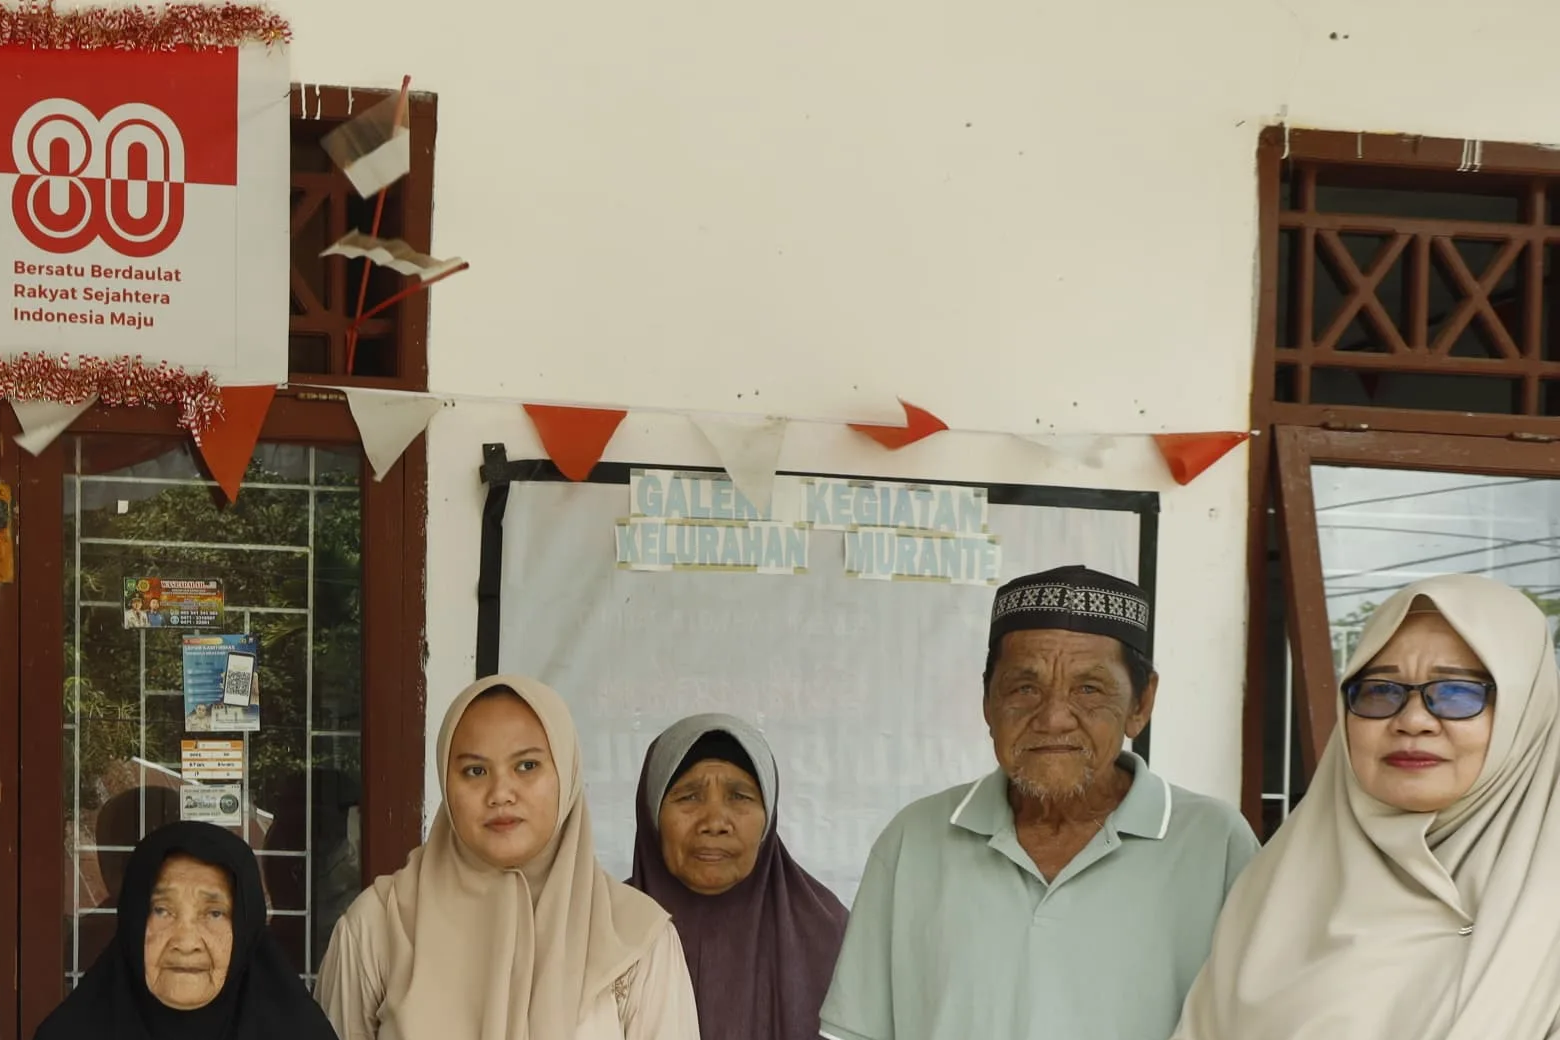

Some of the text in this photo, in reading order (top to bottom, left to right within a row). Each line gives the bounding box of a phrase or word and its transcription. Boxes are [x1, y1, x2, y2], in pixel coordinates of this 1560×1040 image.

[12, 97, 185, 258] 80
[13, 260, 182, 283] Bersatu Berdaulat
[13, 284, 170, 307] Rakyat Sejahtera
[13, 307, 155, 330] Indonesia Maju
[637, 475, 982, 534] GALE KEGIATAN
[620, 522, 997, 581] KELURAHAN MURANTE
